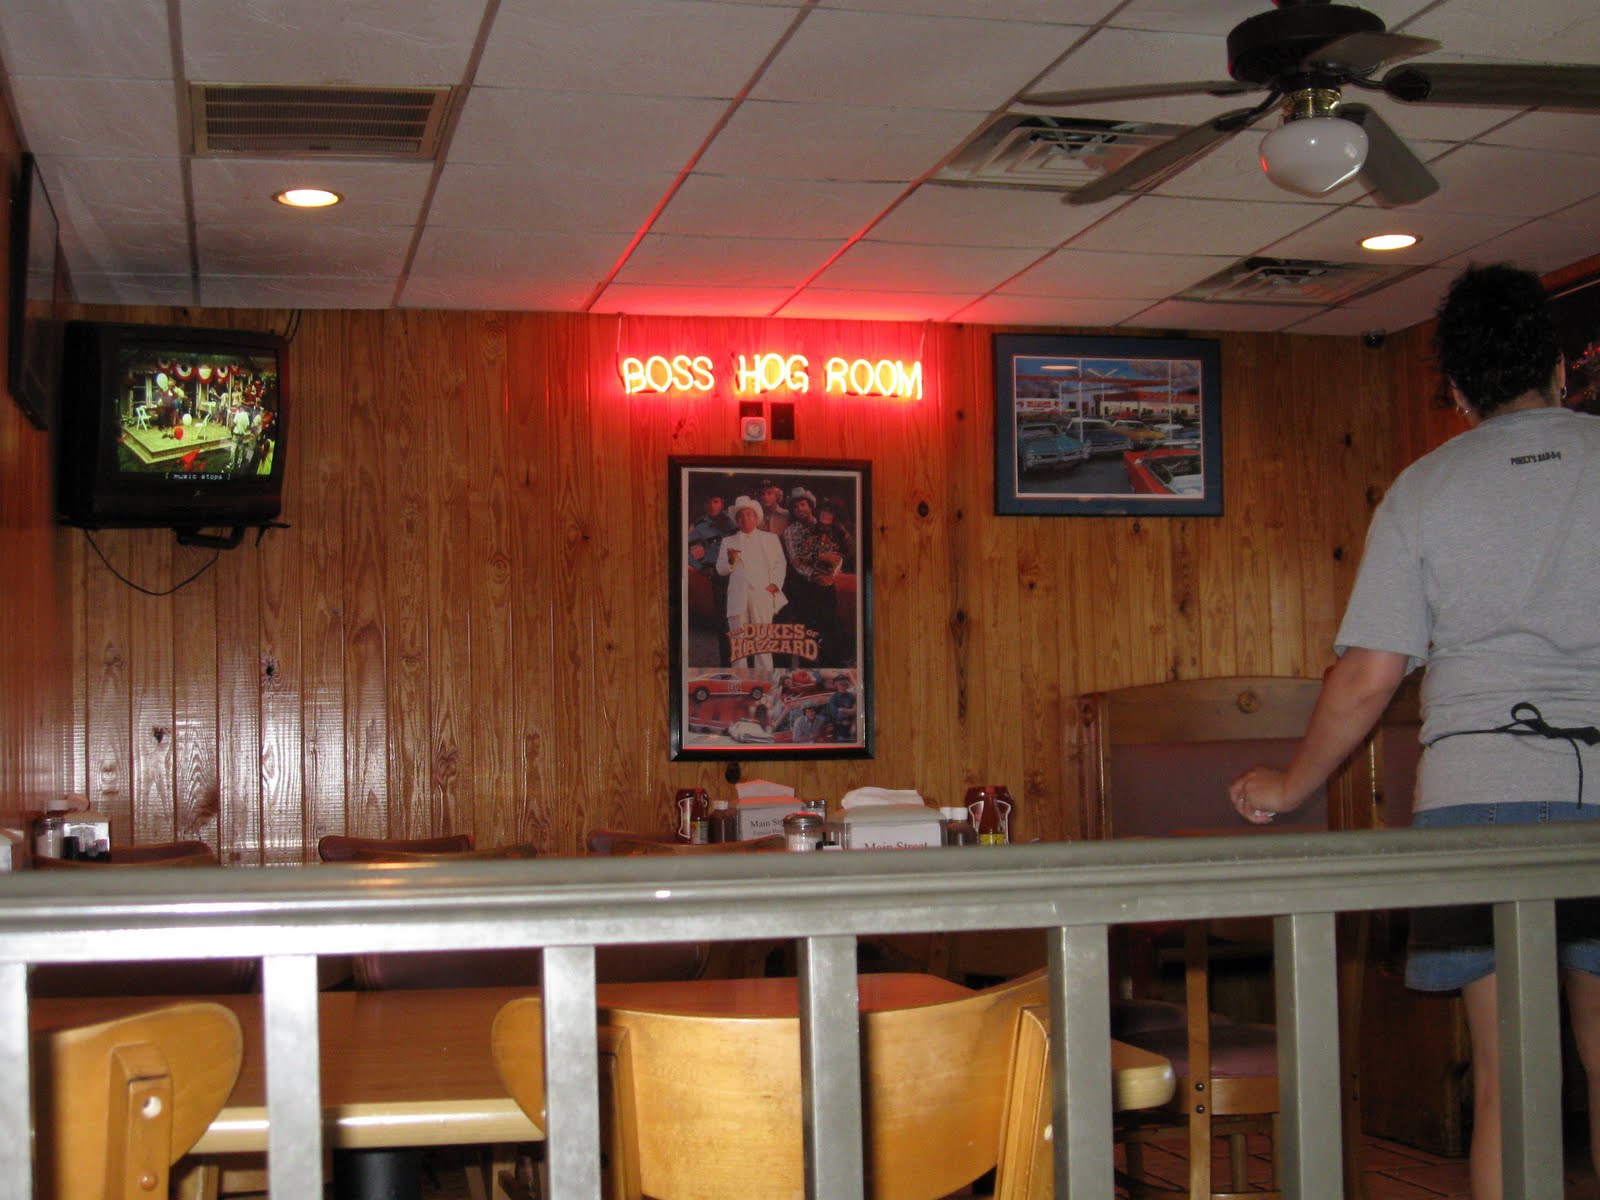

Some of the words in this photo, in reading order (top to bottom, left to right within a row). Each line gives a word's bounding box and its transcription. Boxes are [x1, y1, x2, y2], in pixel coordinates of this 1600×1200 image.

[623, 355, 714, 393] BOSS
[738, 353, 808, 393] HOG
[826, 357, 922, 399] ROOM
[743, 624, 804, 639] DUKES
[730, 638, 818, 663] HAZZARD
[750, 820, 770, 828] Main
